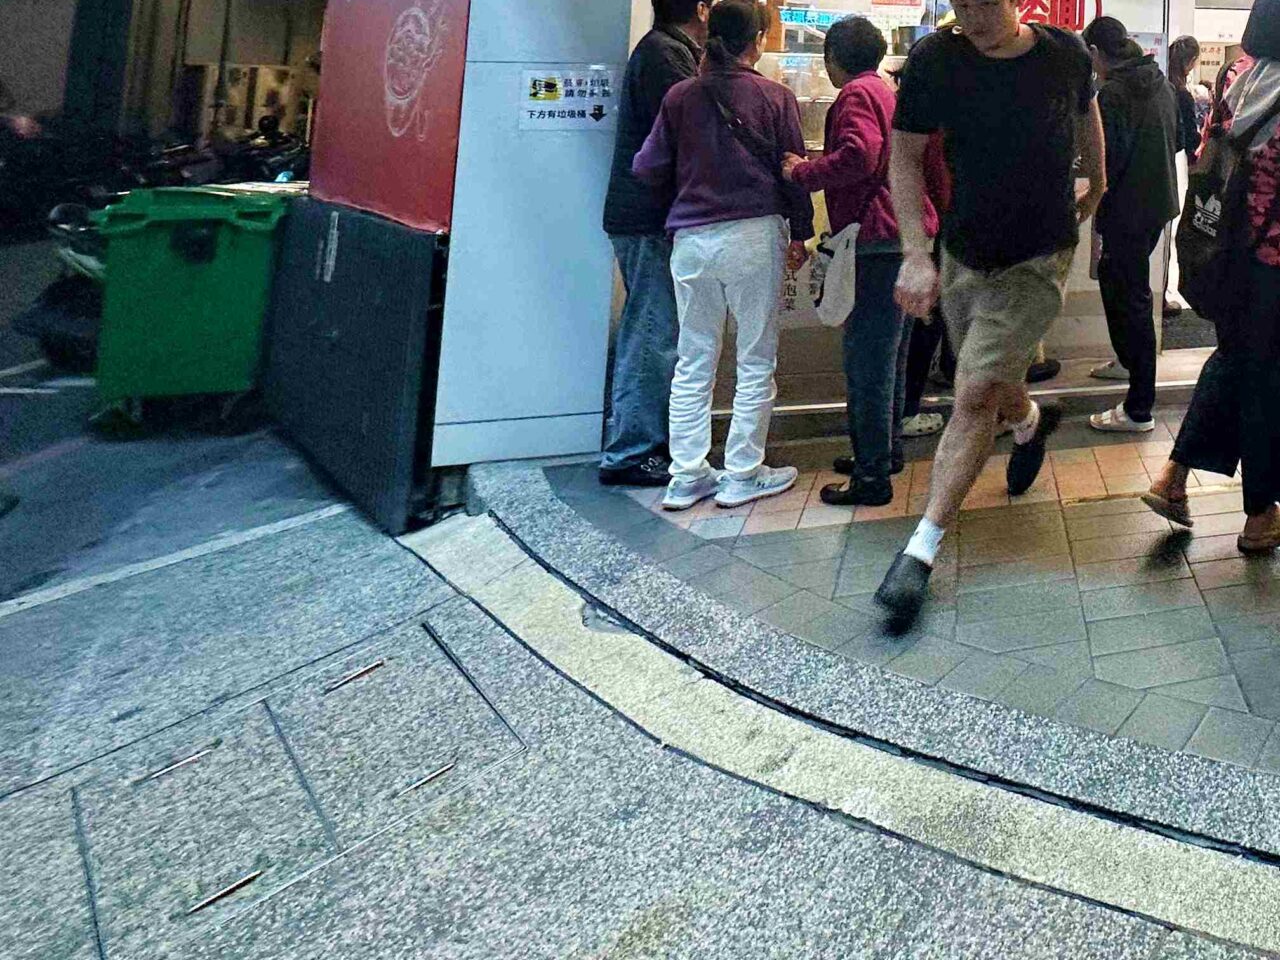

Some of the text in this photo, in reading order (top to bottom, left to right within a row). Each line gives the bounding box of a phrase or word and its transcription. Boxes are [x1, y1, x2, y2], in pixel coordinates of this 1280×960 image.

[527, 109, 586, 119] 下方有垃圾桶
